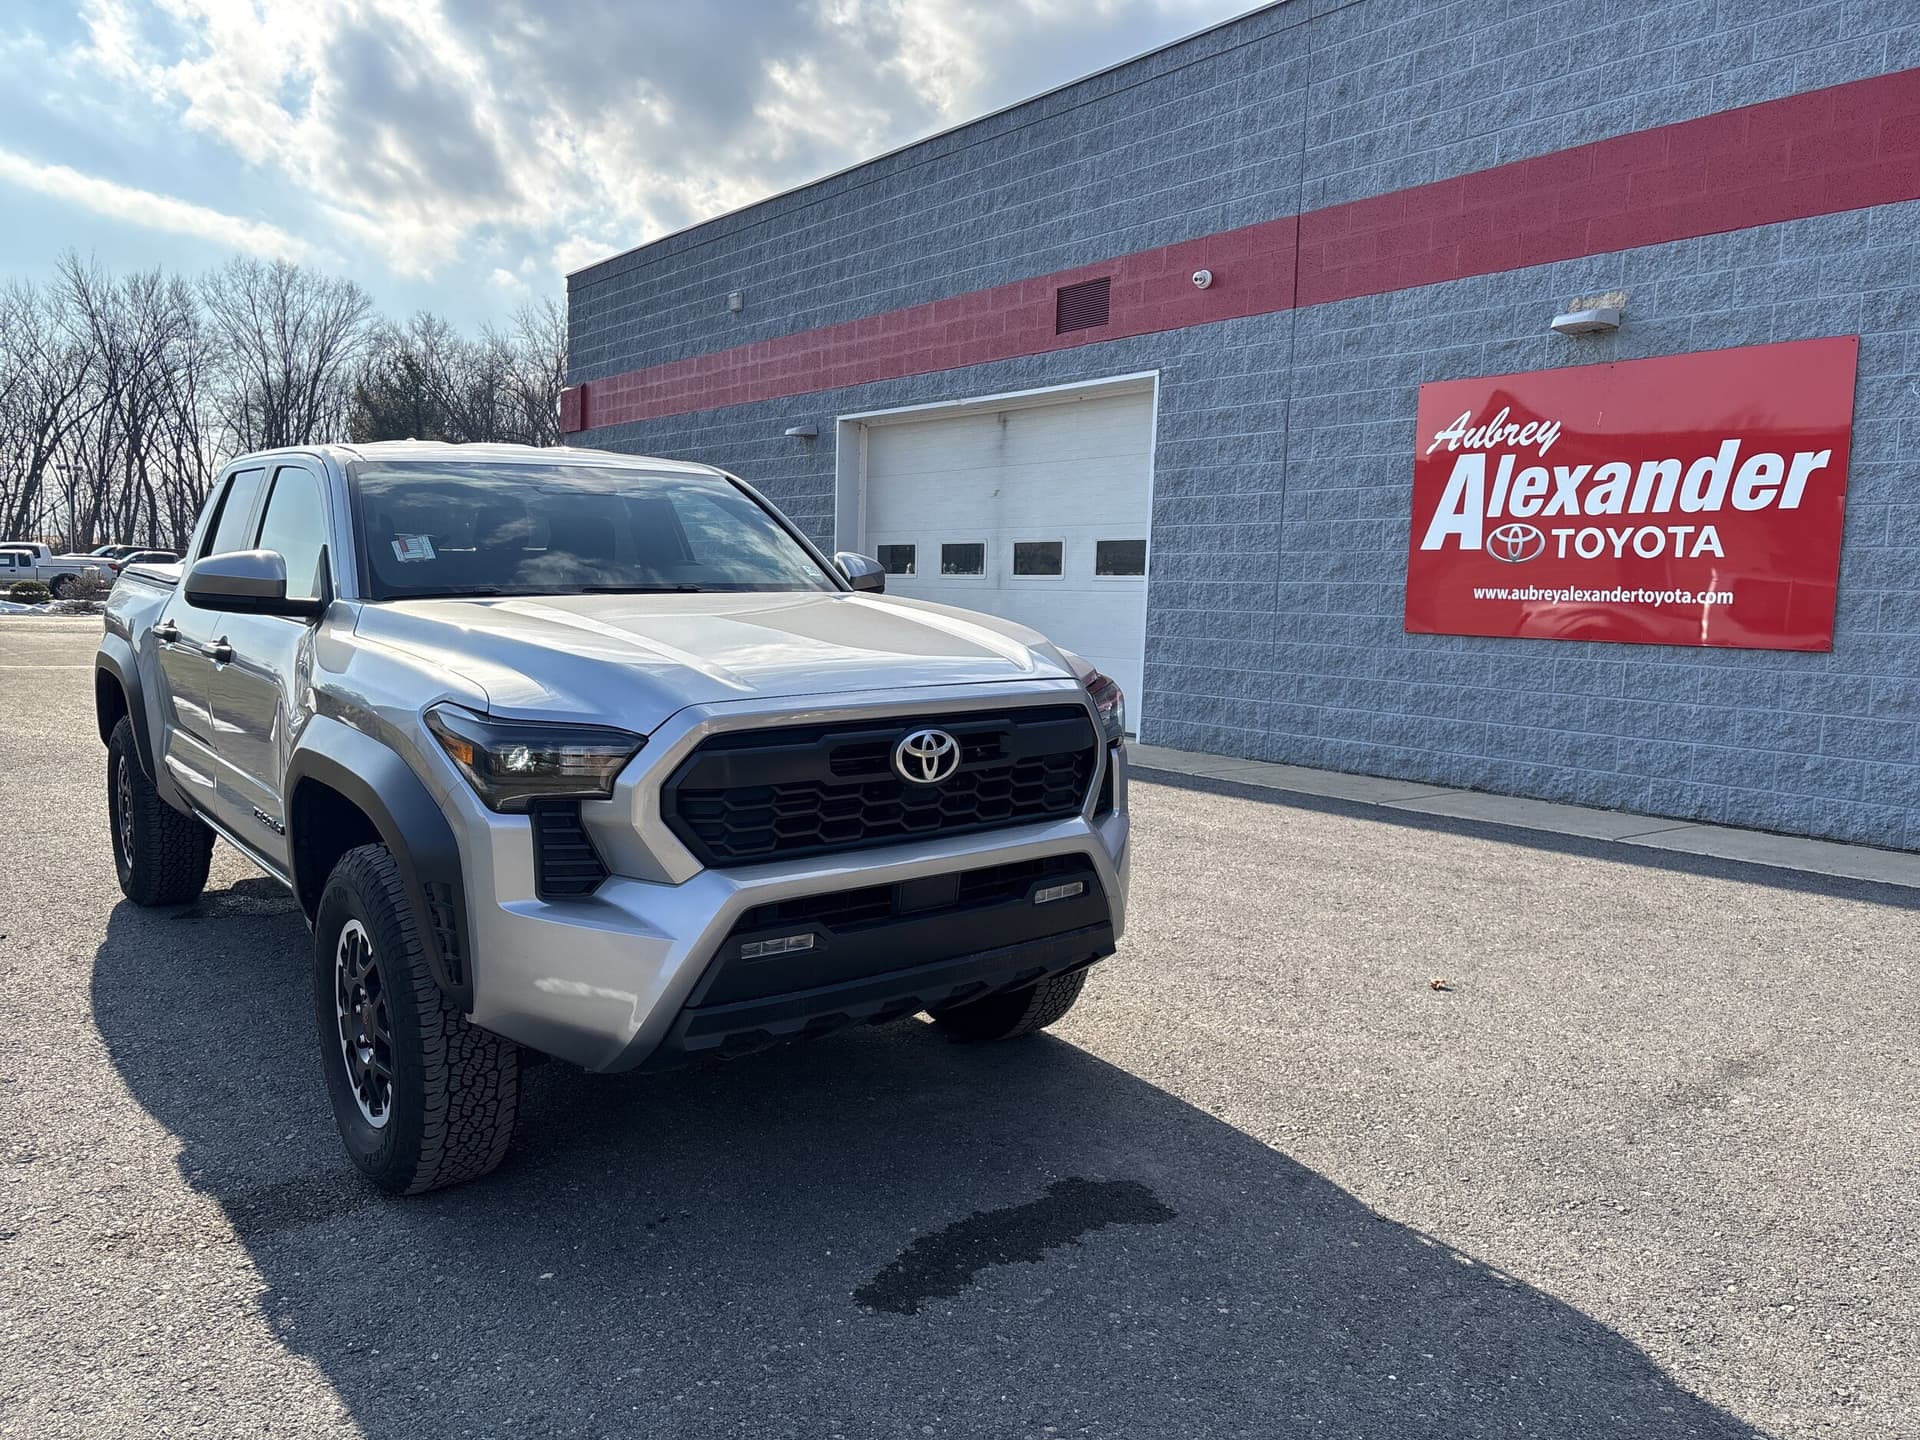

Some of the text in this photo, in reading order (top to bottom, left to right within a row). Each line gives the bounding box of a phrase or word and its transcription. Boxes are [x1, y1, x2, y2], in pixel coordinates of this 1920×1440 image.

[1426, 406, 1561, 457] Aubrey
[1420, 438, 1832, 551] Alexander
[1551, 525, 1725, 559] TOYOTA
[1473, 584, 1734, 609] www.aubreyalexandertoyota.com
